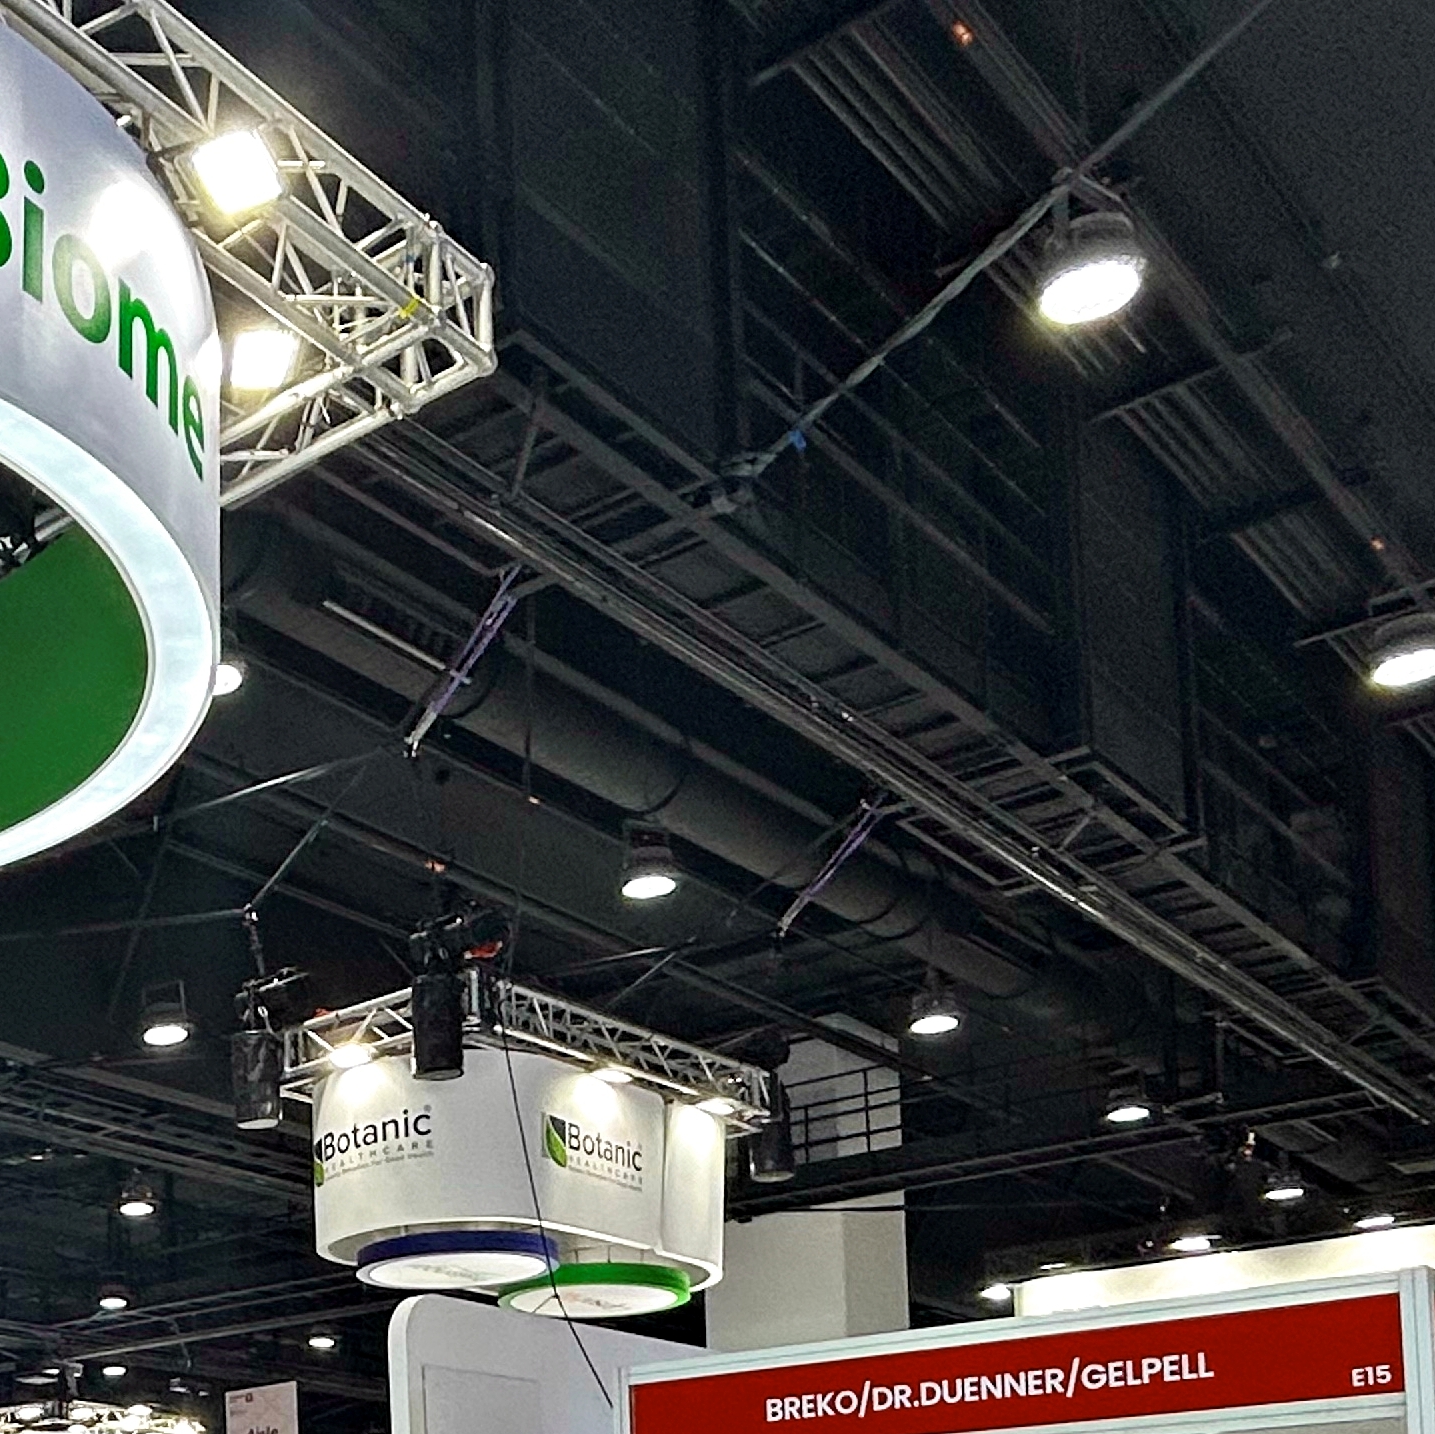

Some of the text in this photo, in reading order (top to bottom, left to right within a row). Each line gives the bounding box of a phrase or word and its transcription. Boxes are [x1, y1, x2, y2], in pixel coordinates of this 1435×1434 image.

[323, 1108, 432, 1162] Botanic
[568, 1122, 643, 1172] Botanic
[765, 1352, 1215, 1423] BREKO/DR.DUENNER/GELPELL
[1351, 1364, 1392, 1388] E15
